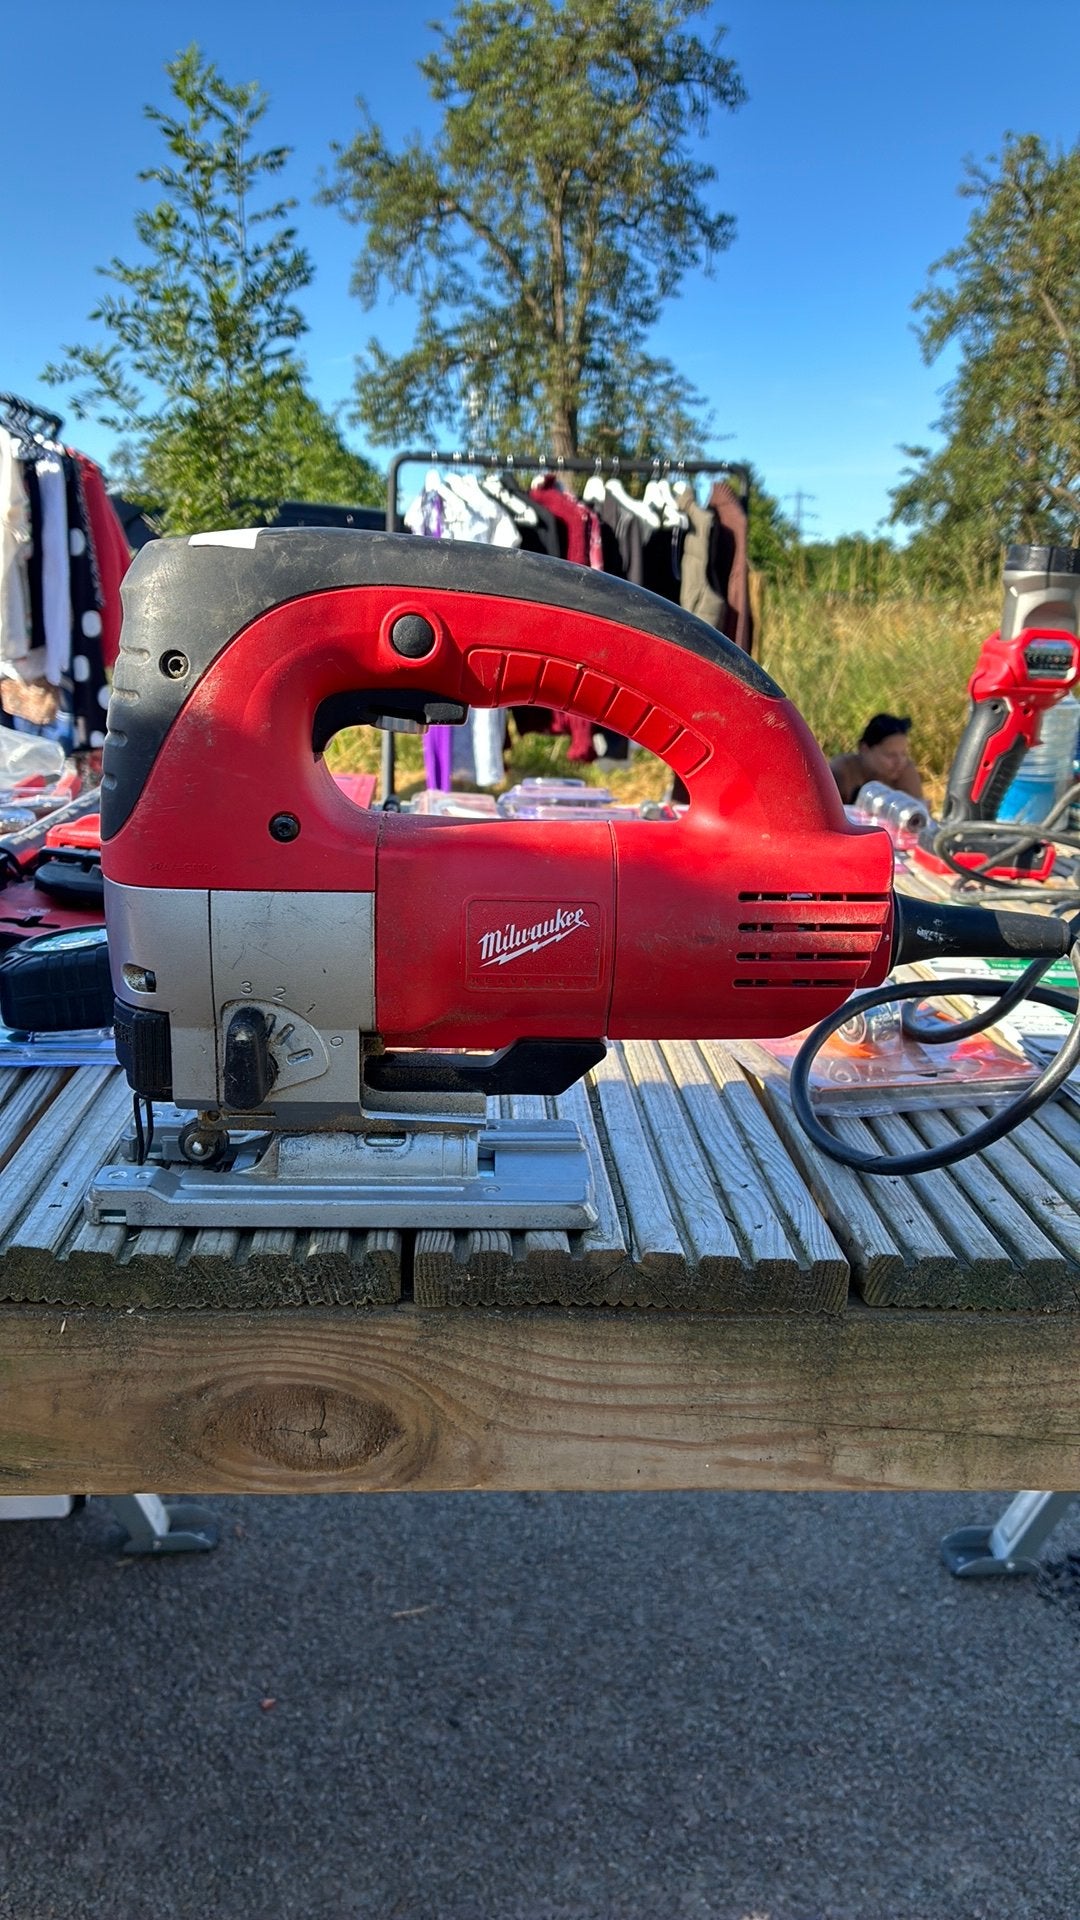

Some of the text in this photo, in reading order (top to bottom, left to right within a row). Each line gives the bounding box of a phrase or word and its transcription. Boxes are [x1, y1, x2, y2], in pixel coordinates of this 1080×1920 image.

[477, 908, 589, 960] Milwaukee
[240, 980, 344, 1048] 3 2 1 0
